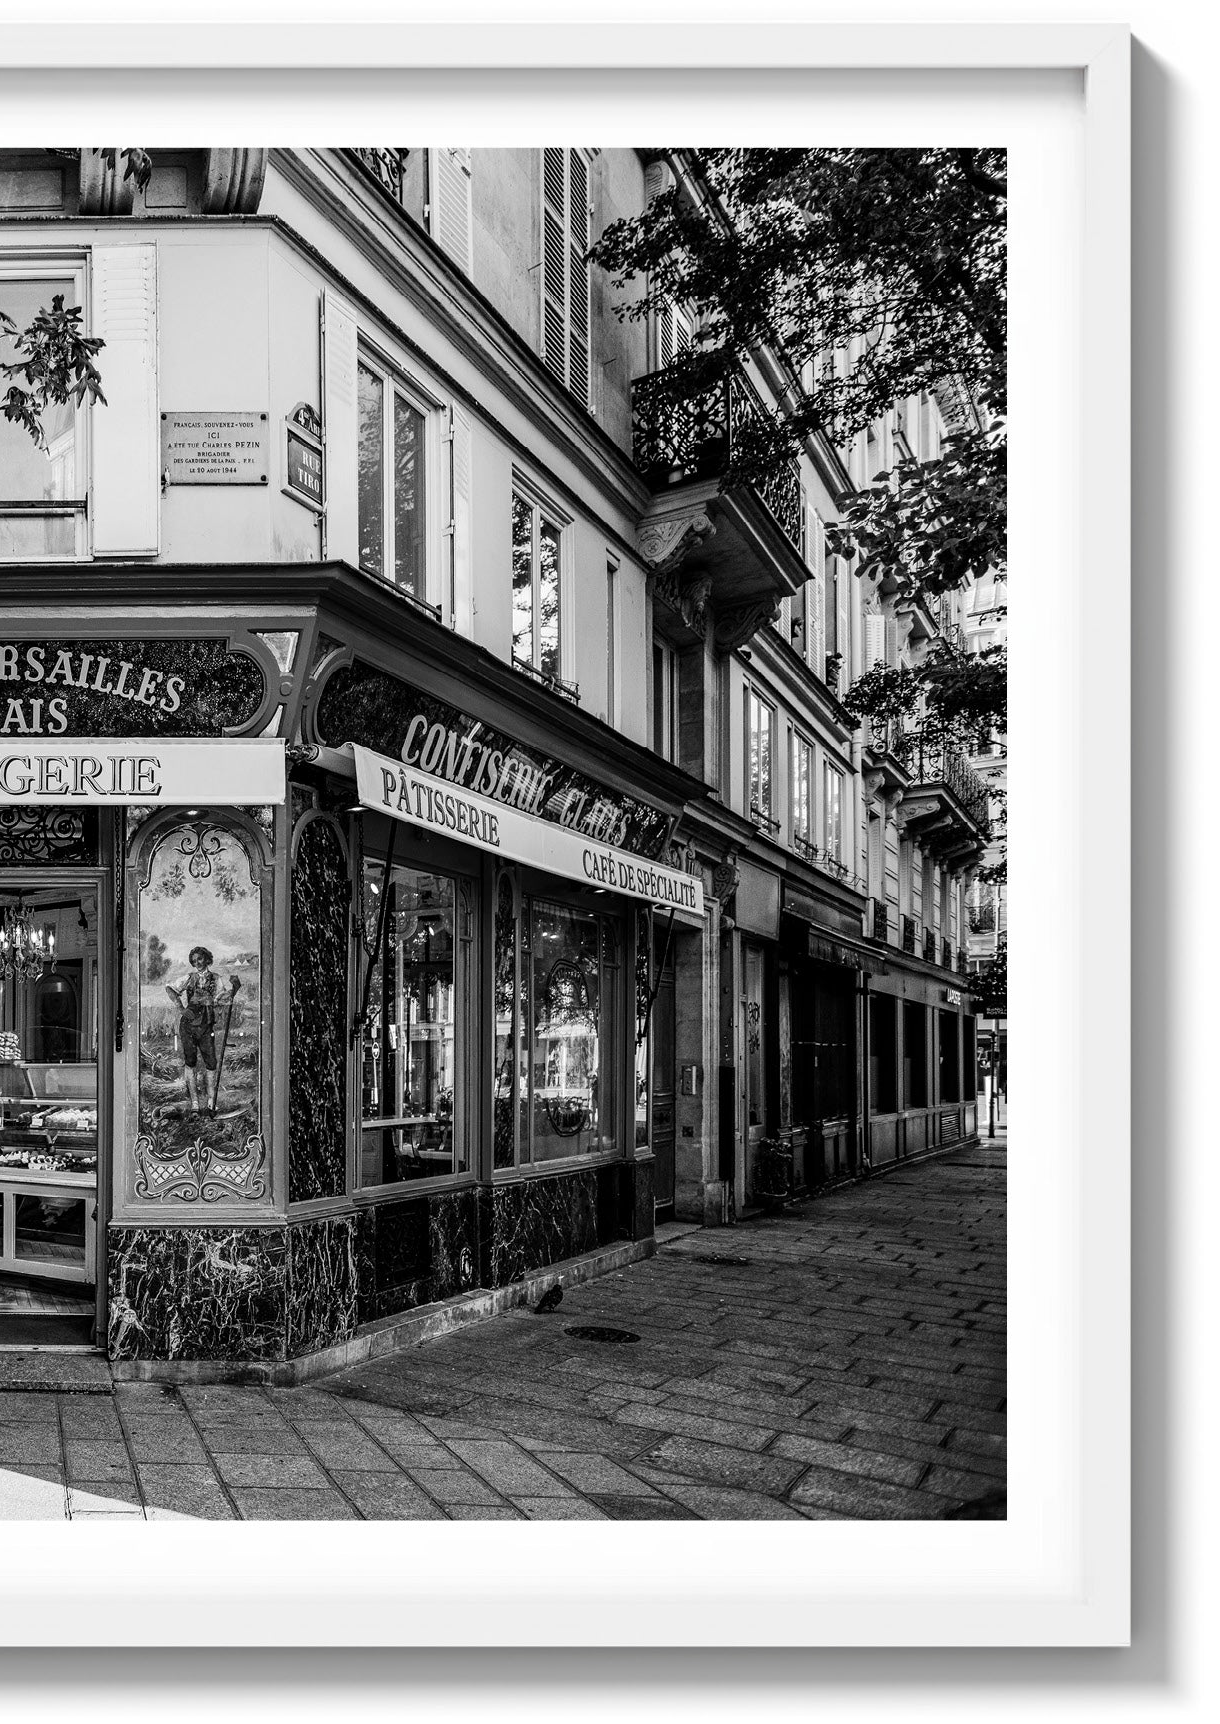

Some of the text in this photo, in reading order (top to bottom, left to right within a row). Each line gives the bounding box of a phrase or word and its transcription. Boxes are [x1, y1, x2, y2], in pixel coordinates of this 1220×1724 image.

[302, 450, 321, 475] RUE
[401, 714, 554, 817] CONFISERIE
[380, 767, 500, 847] PÂTISSERIE
[582, 848, 696, 908] CAFÉ DE SPÉCIALITÉ
